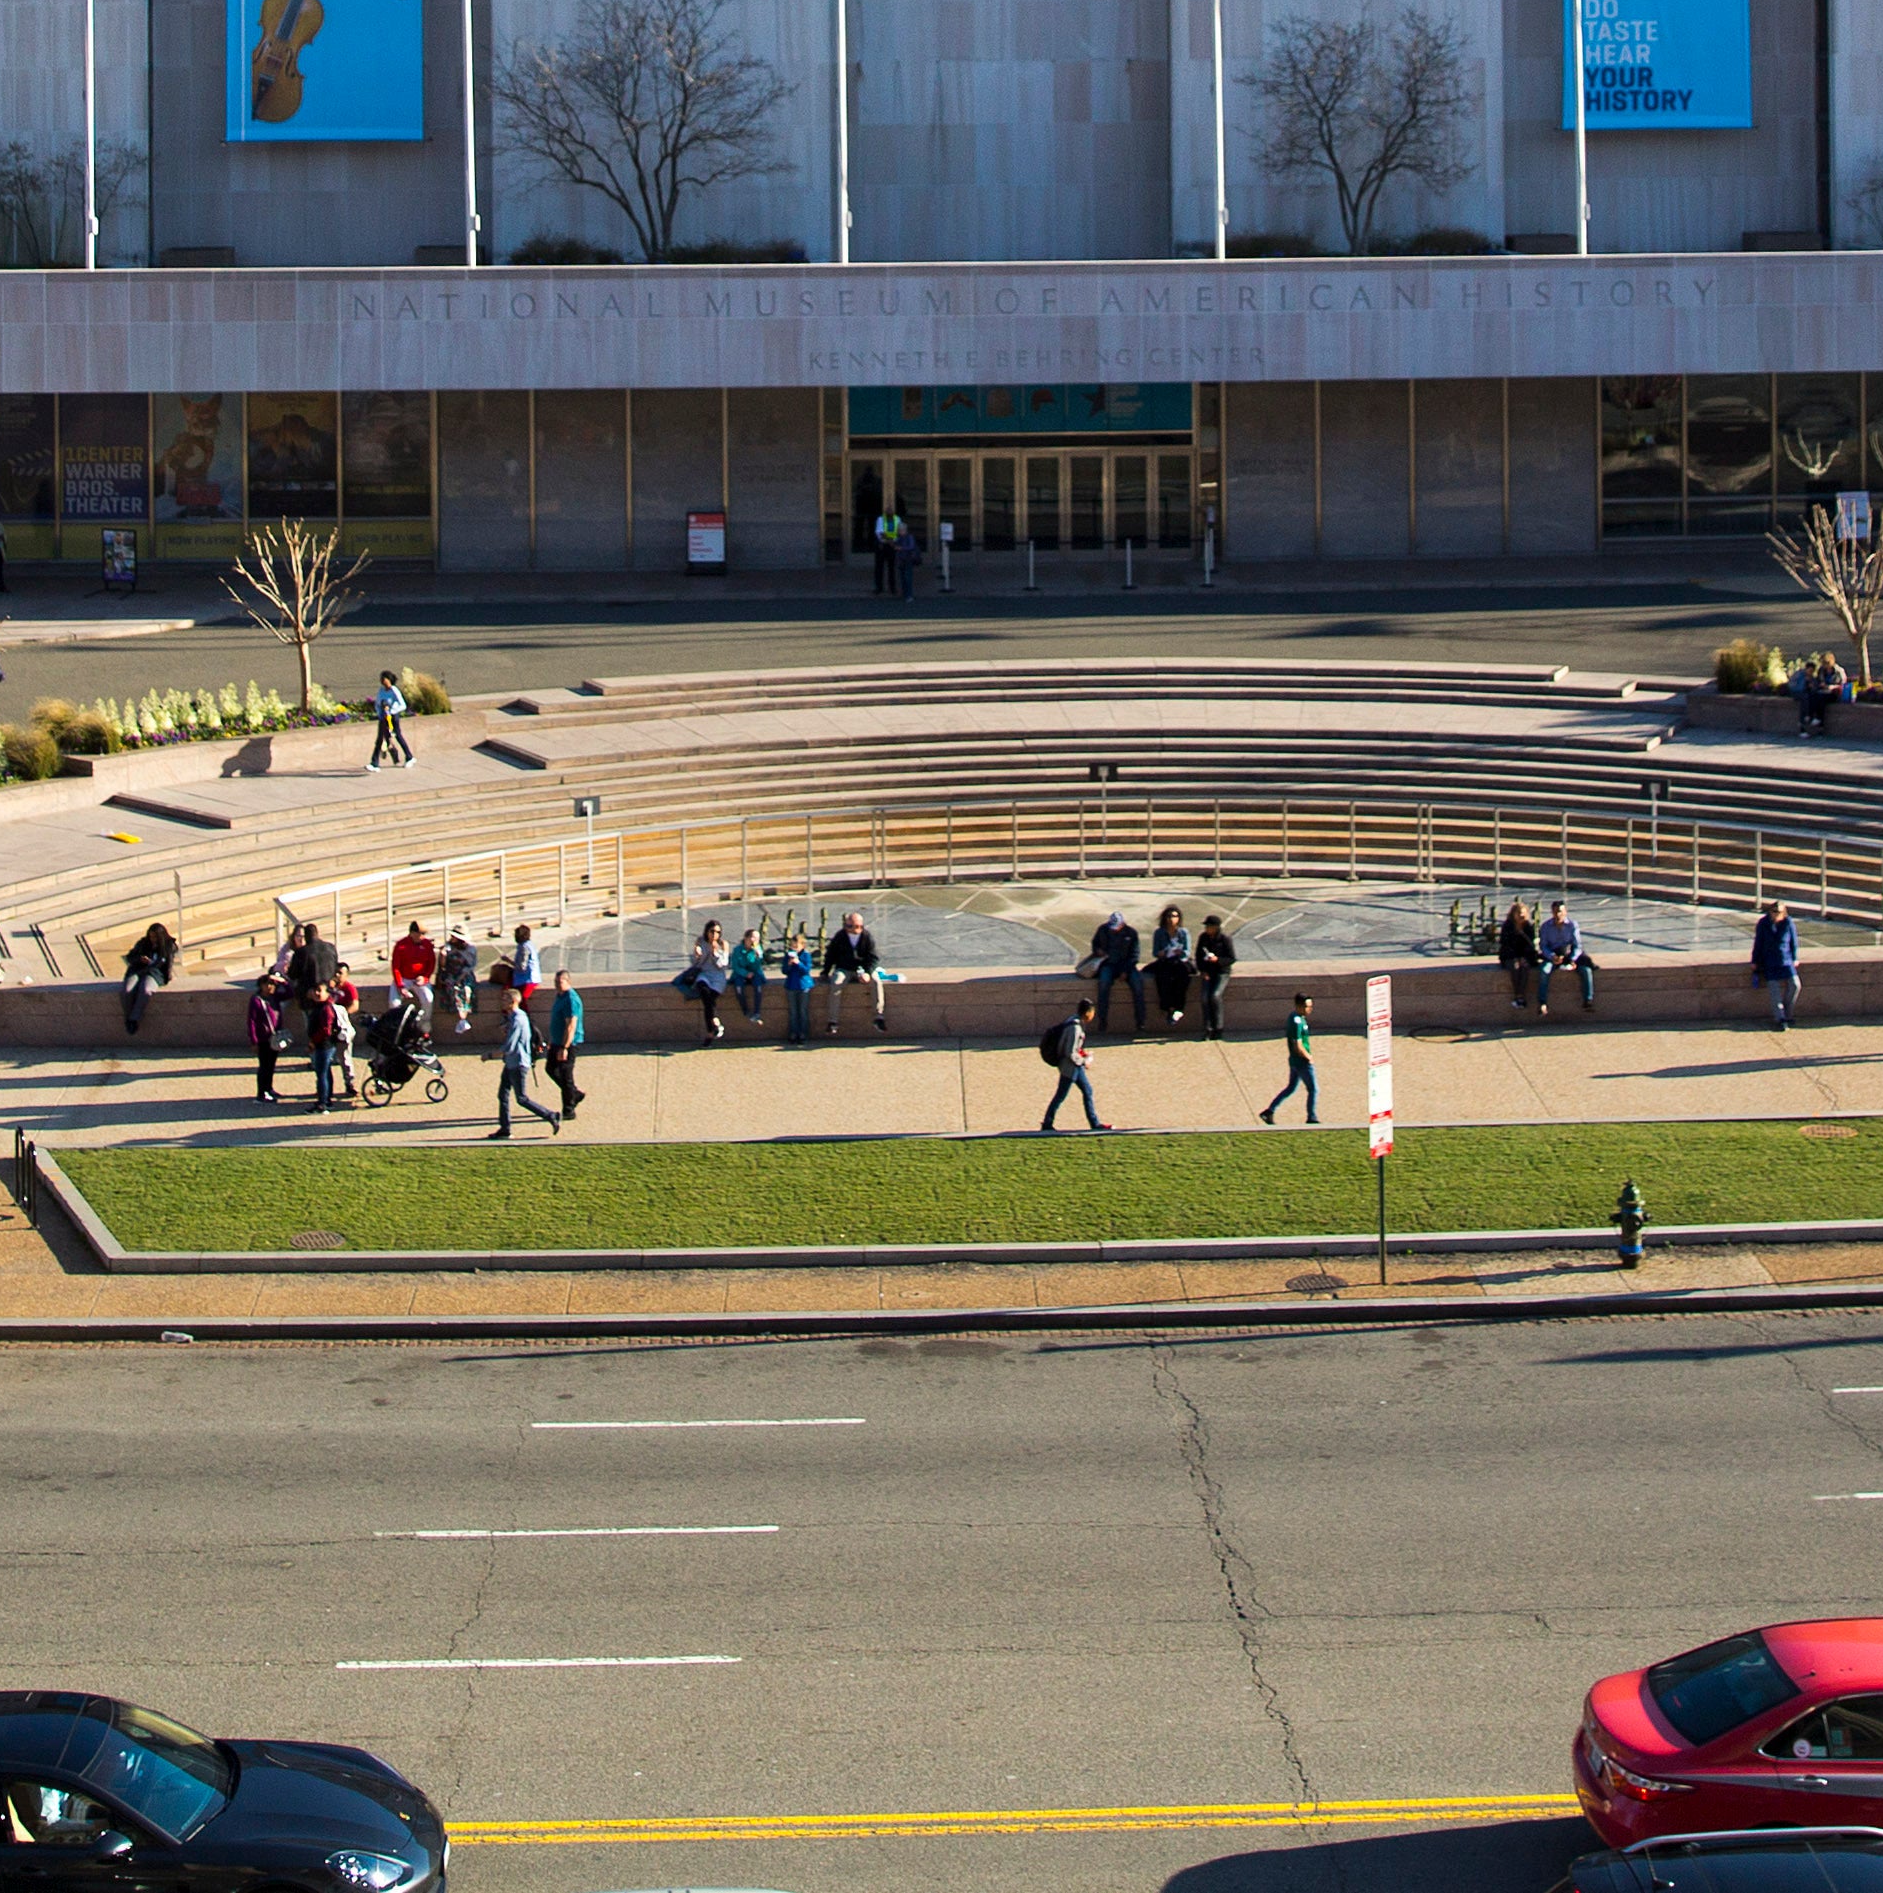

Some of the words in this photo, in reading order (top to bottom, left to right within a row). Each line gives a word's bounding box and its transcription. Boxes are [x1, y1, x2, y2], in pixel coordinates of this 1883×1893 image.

[1584, 20, 1659, 42] TASTE
[1584, 44, 1651, 65] HEAR
[1584, 66, 1653, 88] YOUR
[1584, 89, 1693, 112] HISTORY
[352, 290, 667, 322] NATIONAL
[705, 287, 953, 319] MUSEUM
[995, 287, 1058, 316] OF
[1100, 283, 1416, 313] AMERICAN
[1461, 278, 1717, 309] HISTORY
[809, 349, 950, 371] KENNETH
[965, 349, 978, 369] E
[996, 347, 1133, 369] BEHRING
[1147, 345, 1265, 368] CENTER
[65, 463, 143, 480] WARNER
[65, 480, 118, 497] BROS.
[65, 496, 143, 514] THEATER
